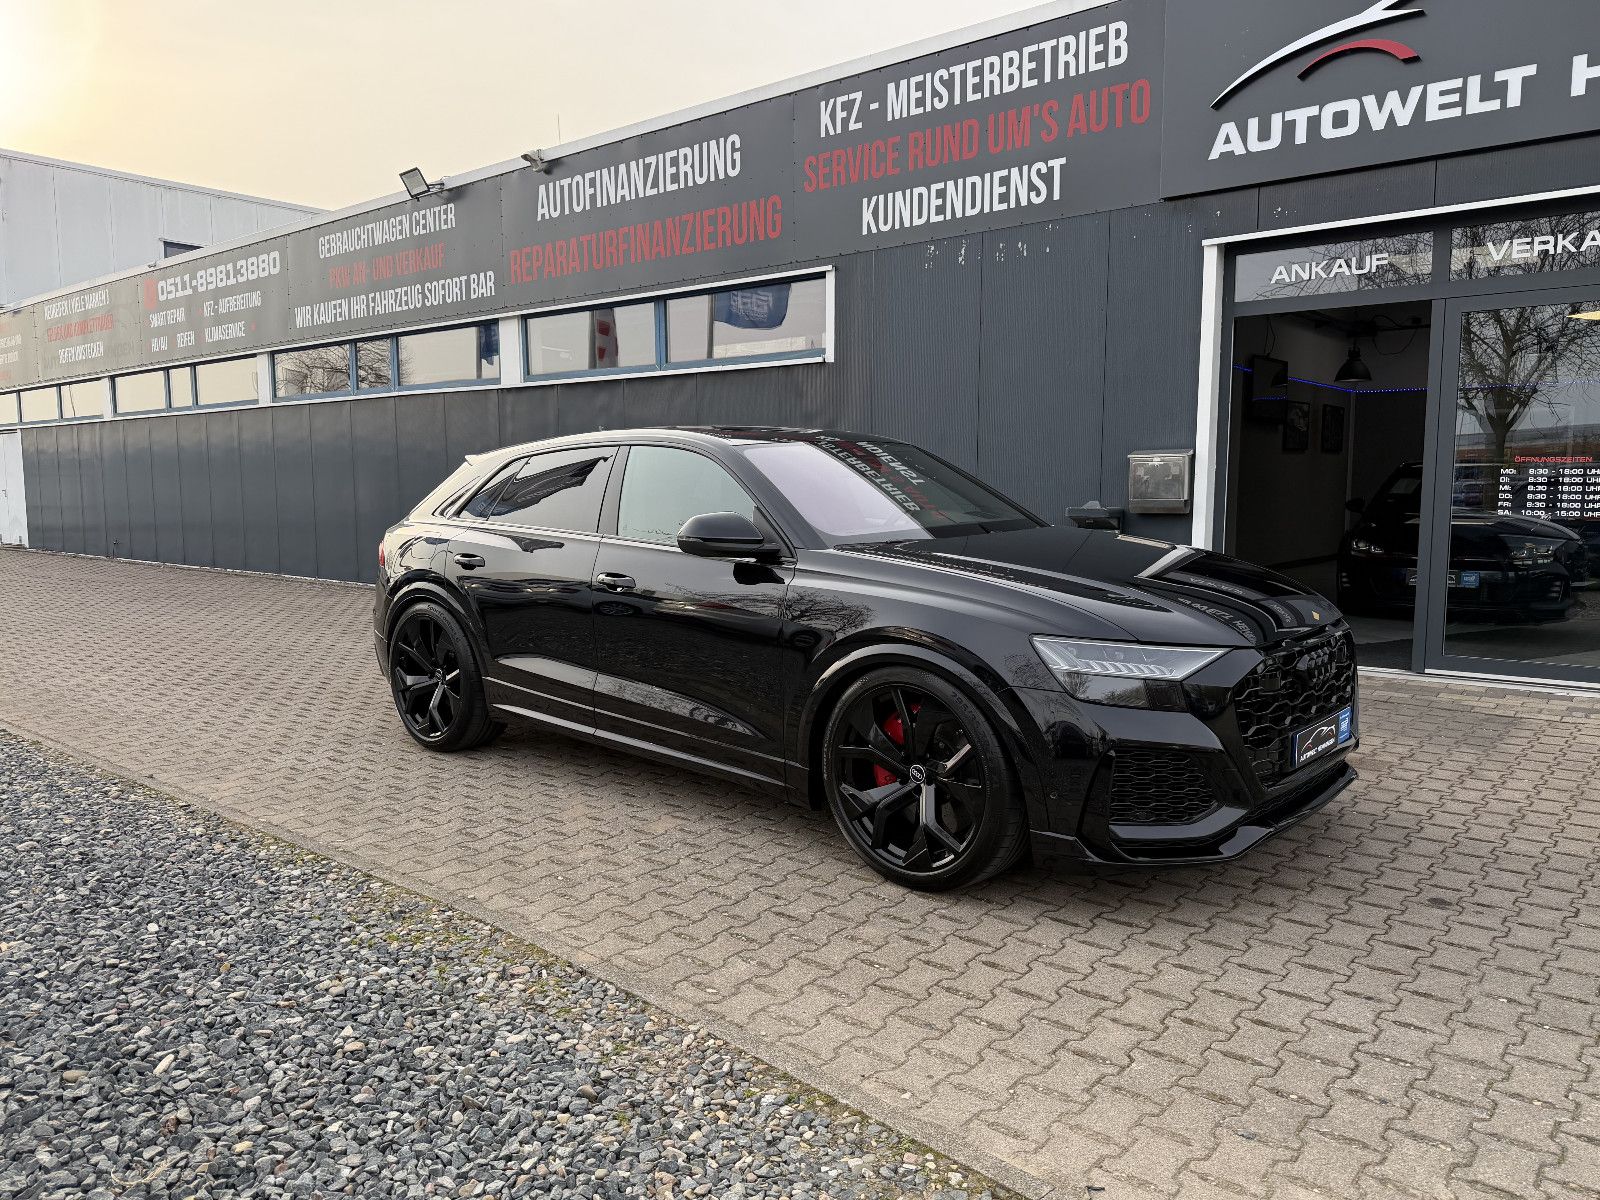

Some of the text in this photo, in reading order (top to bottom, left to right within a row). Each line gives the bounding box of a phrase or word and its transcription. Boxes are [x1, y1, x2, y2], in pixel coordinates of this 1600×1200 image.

[820, 91, 863, 138] KFZ
[887, 20, 1129, 122] MEISTERBETRIEB
[803, 79, 1151, 193] SERVICE RUND UM'S AUTO
[1208, 63, 1538, 161] AUTOWELT
[537, 133, 742, 222] AUTOFINANZIERUNG
[862, 156, 1068, 236] KUNDENDIENST
[318, 203, 456, 259] GEBRAUCHTWAGEN CENTER
[510, 194, 783, 285] REPARATURFINANZIERUNG
[328, 266, 350, 289] PKW
[372, 255, 394, 281] UND
[395, 240, 447, 276] VERKAUF
[1270, 252, 1390, 285] ANKAUF
[203, 301, 214, 317] KFZ
[218, 290, 262, 314] AUFBEREITUNG
[295, 271, 496, 329] WIR KAUFEN IHR FAHRZEUG SOFORT BAR
[177, 331, 195, 348] REIFEN
[205, 321, 246, 343] KLIMASERVICE
[1514, 455, 1593, 463] ÖFFNUNGSZEITEN
